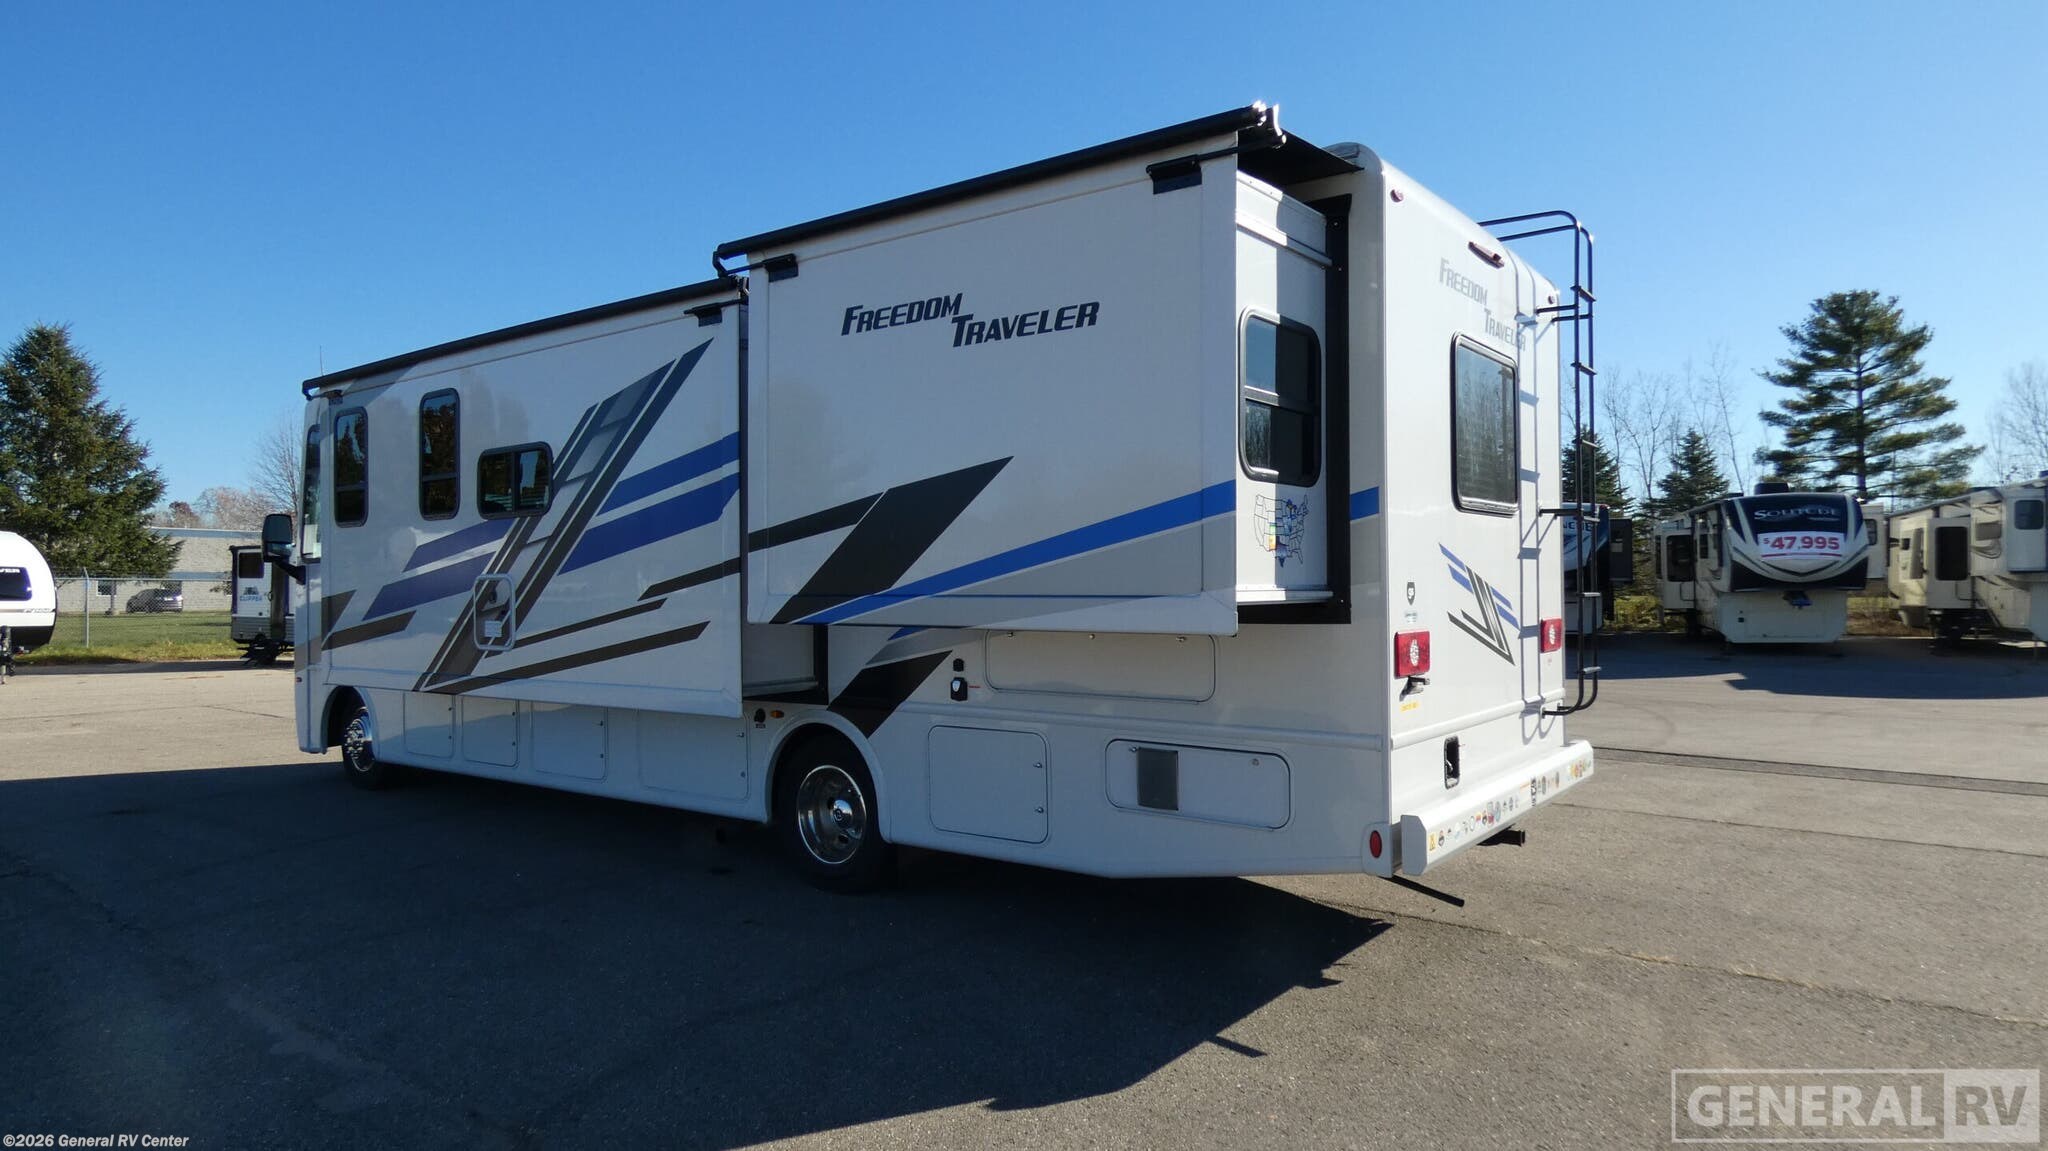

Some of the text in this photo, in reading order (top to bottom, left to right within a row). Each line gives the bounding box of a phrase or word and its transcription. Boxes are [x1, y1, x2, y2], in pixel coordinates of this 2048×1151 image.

[1439, 257, 1488, 305] FREEDOM
[841, 293, 963, 336] FREEDOM
[952, 301, 1100, 348] TRAVELER
[1762, 536, 1840, 550] $47,995
